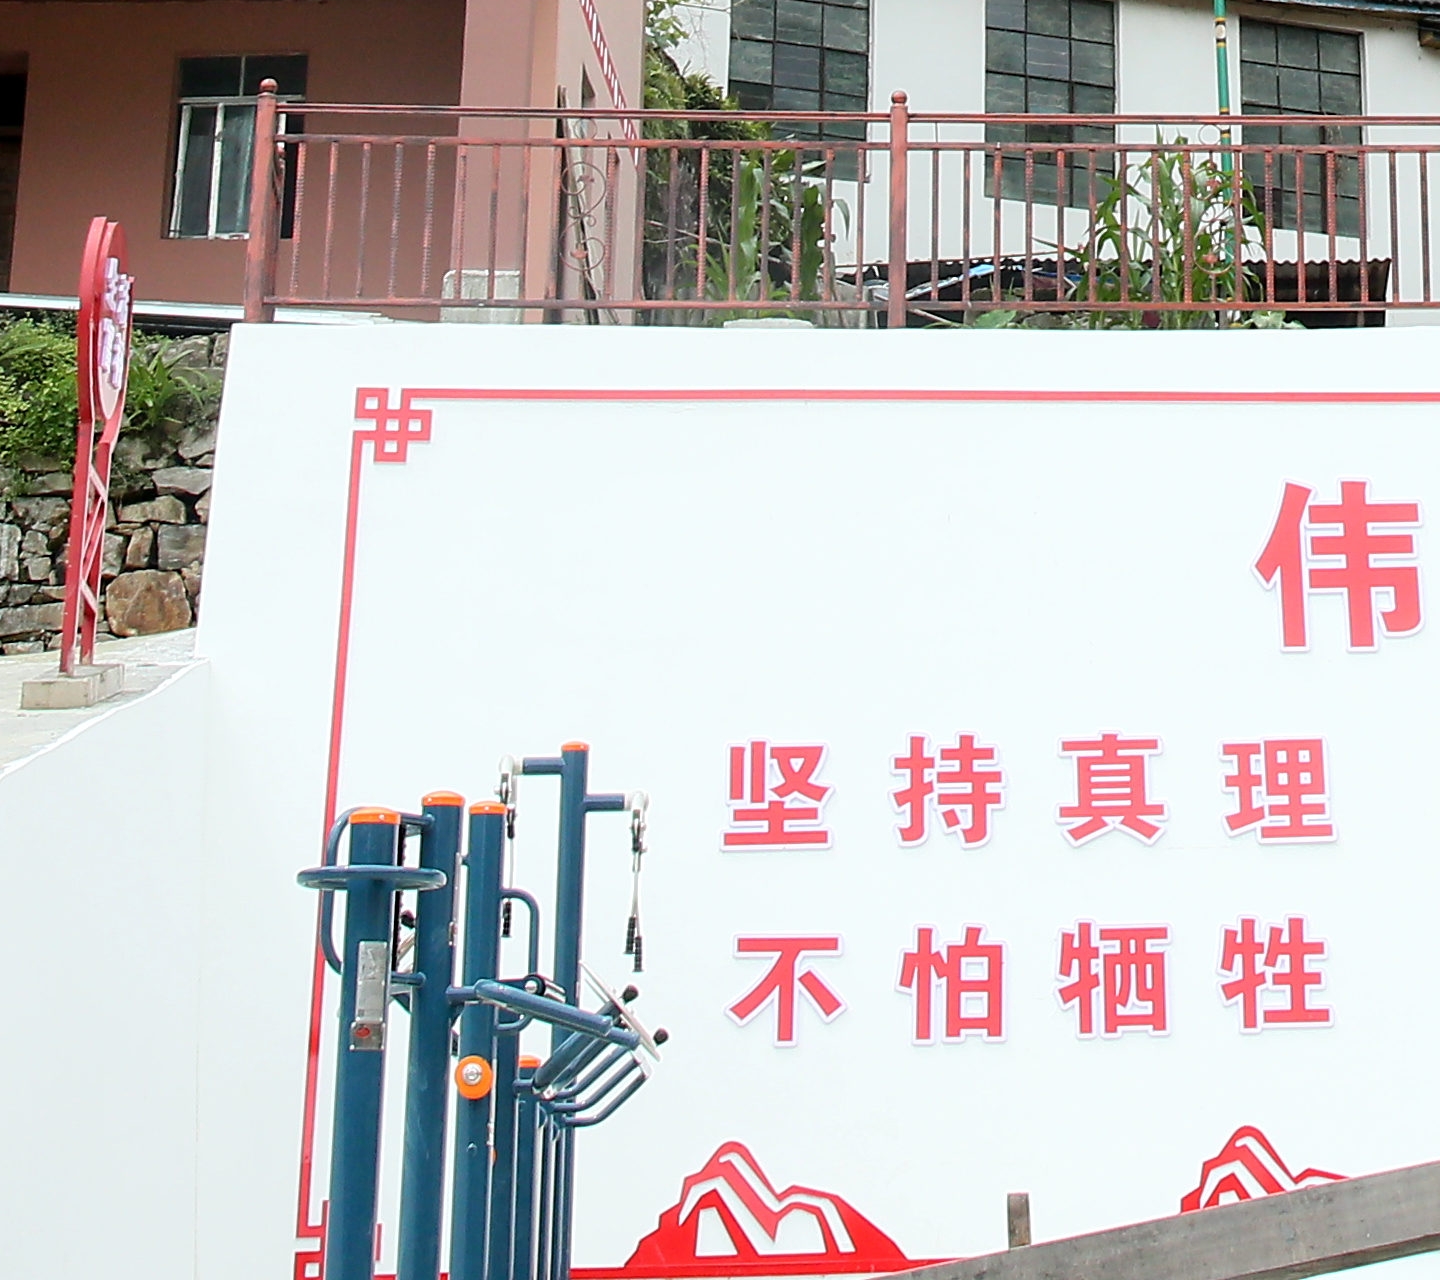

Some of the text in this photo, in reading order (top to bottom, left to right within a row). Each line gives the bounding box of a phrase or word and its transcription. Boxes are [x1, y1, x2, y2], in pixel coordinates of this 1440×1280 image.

[722, 732, 1334, 848] 坚持真理
[729, 916, 1332, 1042] 不怕牺牲
